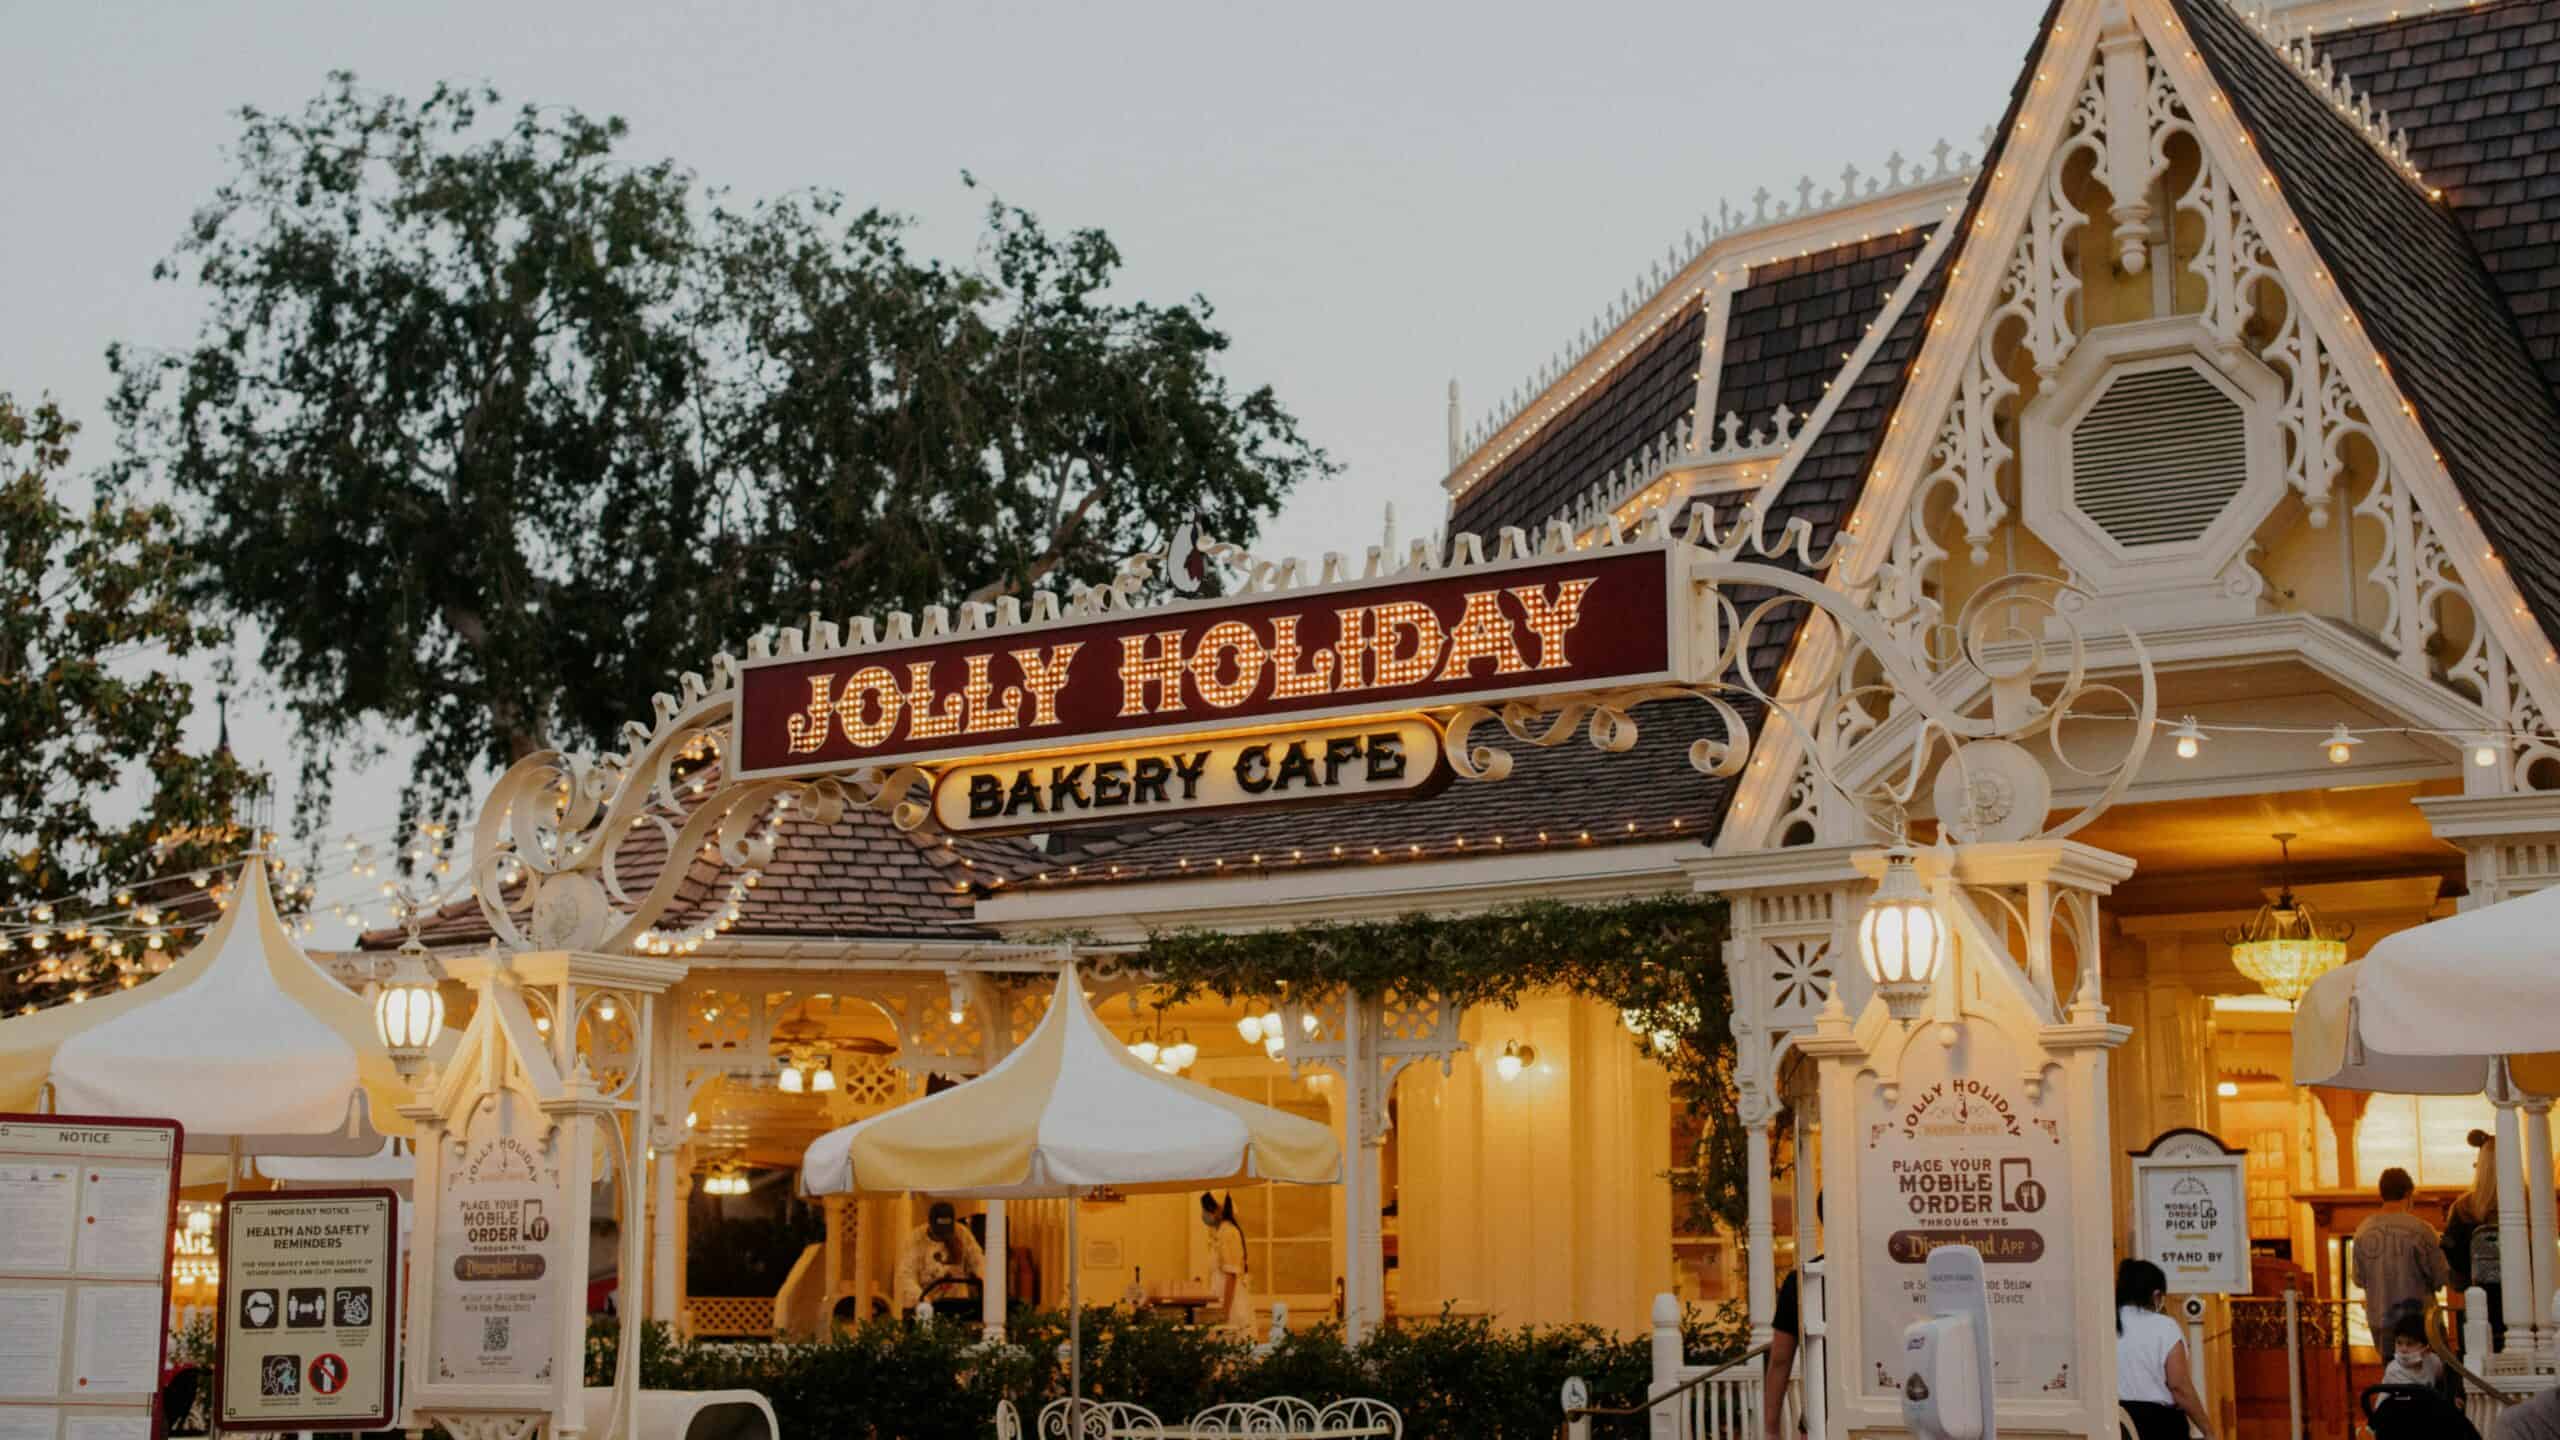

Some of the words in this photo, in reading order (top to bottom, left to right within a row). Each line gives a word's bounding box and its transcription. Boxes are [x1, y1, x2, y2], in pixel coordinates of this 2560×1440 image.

[788, 642, 1086, 754] JOLLY
[1117, 577, 1599, 717] HOLIDAY
[968, 749, 1212, 819] BAKERY
[1233, 732, 1407, 795] CAFE
[1903, 1082, 1943, 1140] JOLLY
[1953, 1079, 2022, 1137] HOLIDAY
[59, 1131, 112, 1144] NOTICE
[468, 1141, 494, 1184] JOLLY
[498, 1136, 538, 1183] HOLIDAY
[1892, 1159, 1943, 1173] PLACE
[1950, 1158, 1992, 1172] YOUR
[1899, 1174, 1993, 1193] MOBILE
[460, 1199, 490, 1211] PLACE
[495, 1199, 520, 1210] YOUR
[1908, 1195, 1993, 1214] ORDER
[463, 1210, 520, 1227] MOBILE
[1920, 1218, 1978, 1227] THROUGH
[1984, 1217, 2009, 1226] THE
[2165, 1220, 2195, 1230] PICK
[2200, 1219, 2217, 1230] UP
[246, 1226, 294, 1238] HEALTH
[296, 1225, 322, 1236] AND
[324, 1224, 370, 1236] SAFETY
[468, 1226, 519, 1242] ORDER
[273, 1238, 342, 1250] REMINDERS
[2161, 1251, 2202, 1262] STAND
[2207, 1251, 2223, 1262] BY
